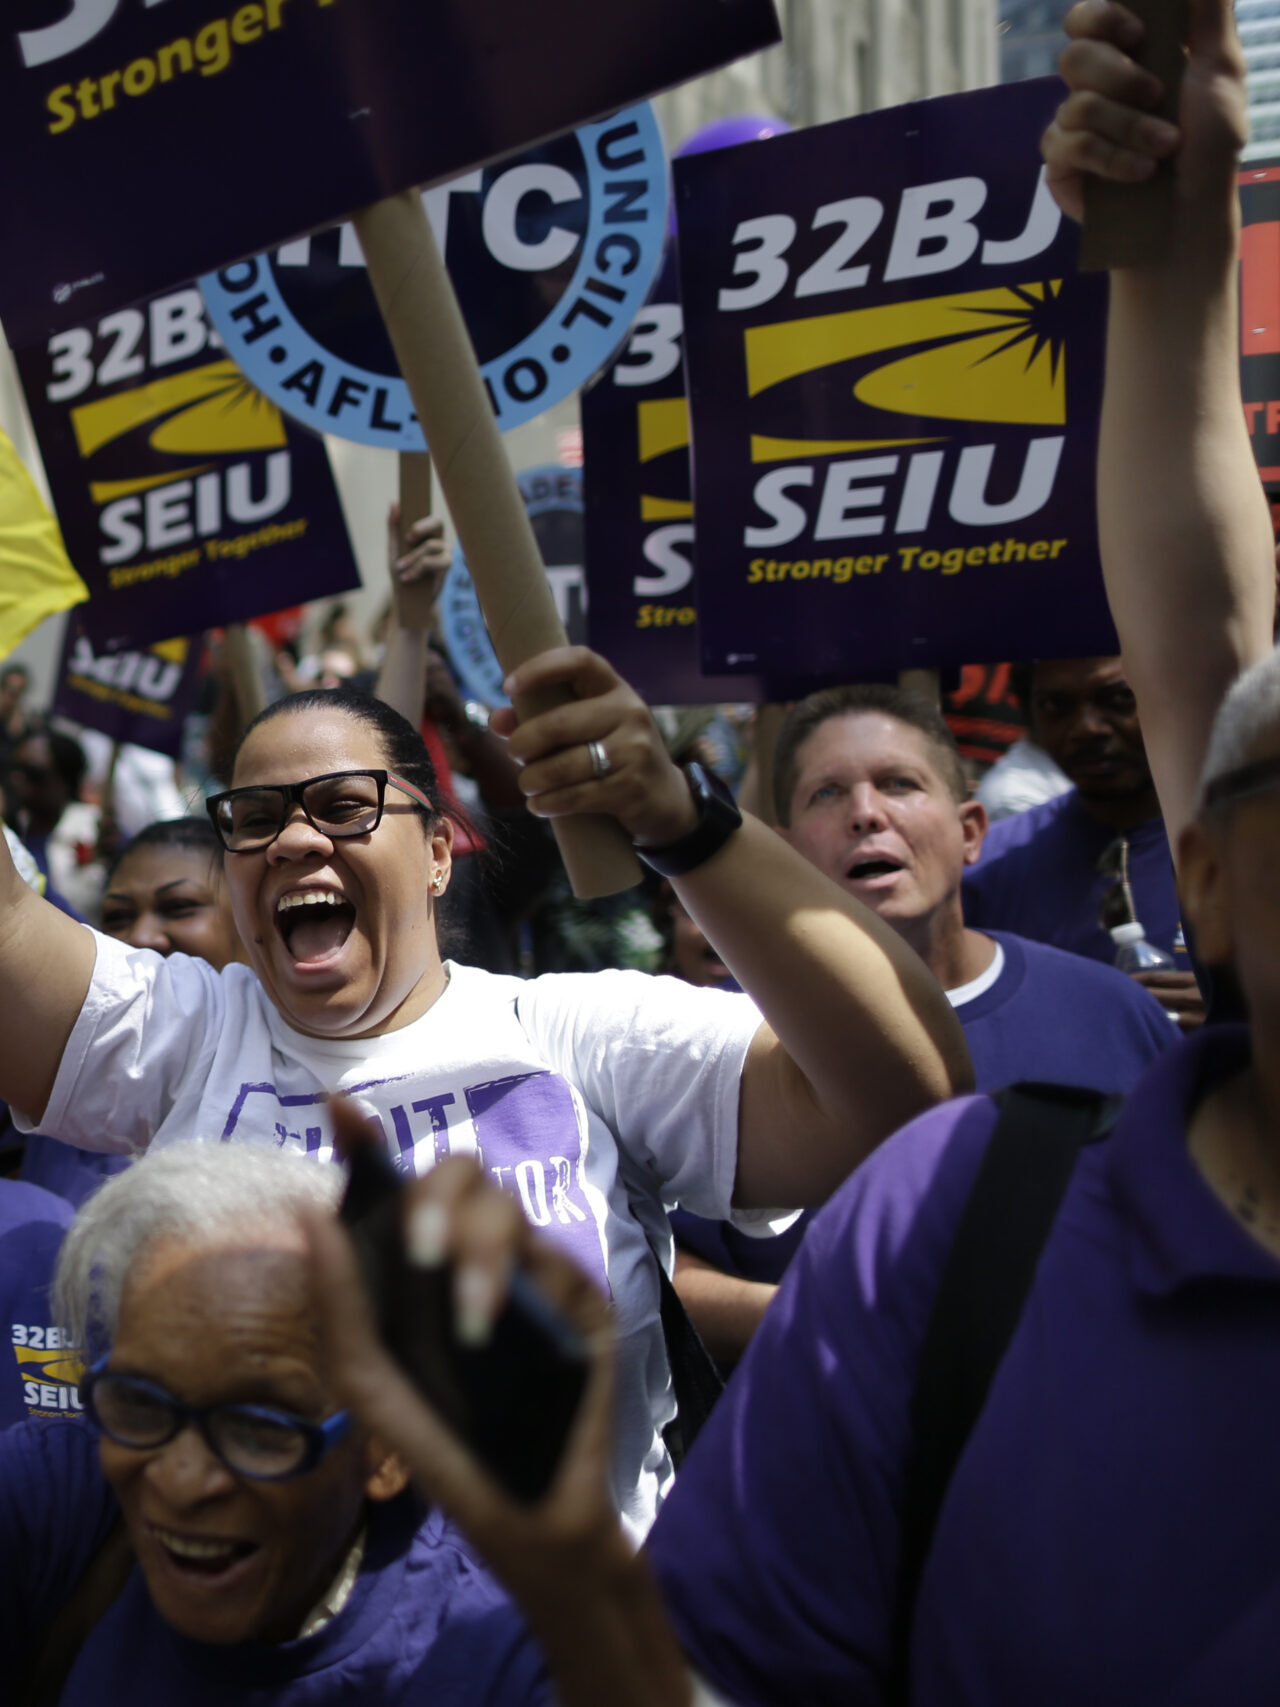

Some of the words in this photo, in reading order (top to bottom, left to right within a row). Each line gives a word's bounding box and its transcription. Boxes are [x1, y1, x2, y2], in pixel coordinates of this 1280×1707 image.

[561, 118, 649, 330] UNCIL
[718, 164, 1062, 311] 32BJ
[46, 288, 224, 401] 32B
[98, 450, 292, 565] SEIU
[744, 436, 1065, 547] SEIU
[747, 554, 889, 583] Stronger
[898, 538, 1067, 575] Together
